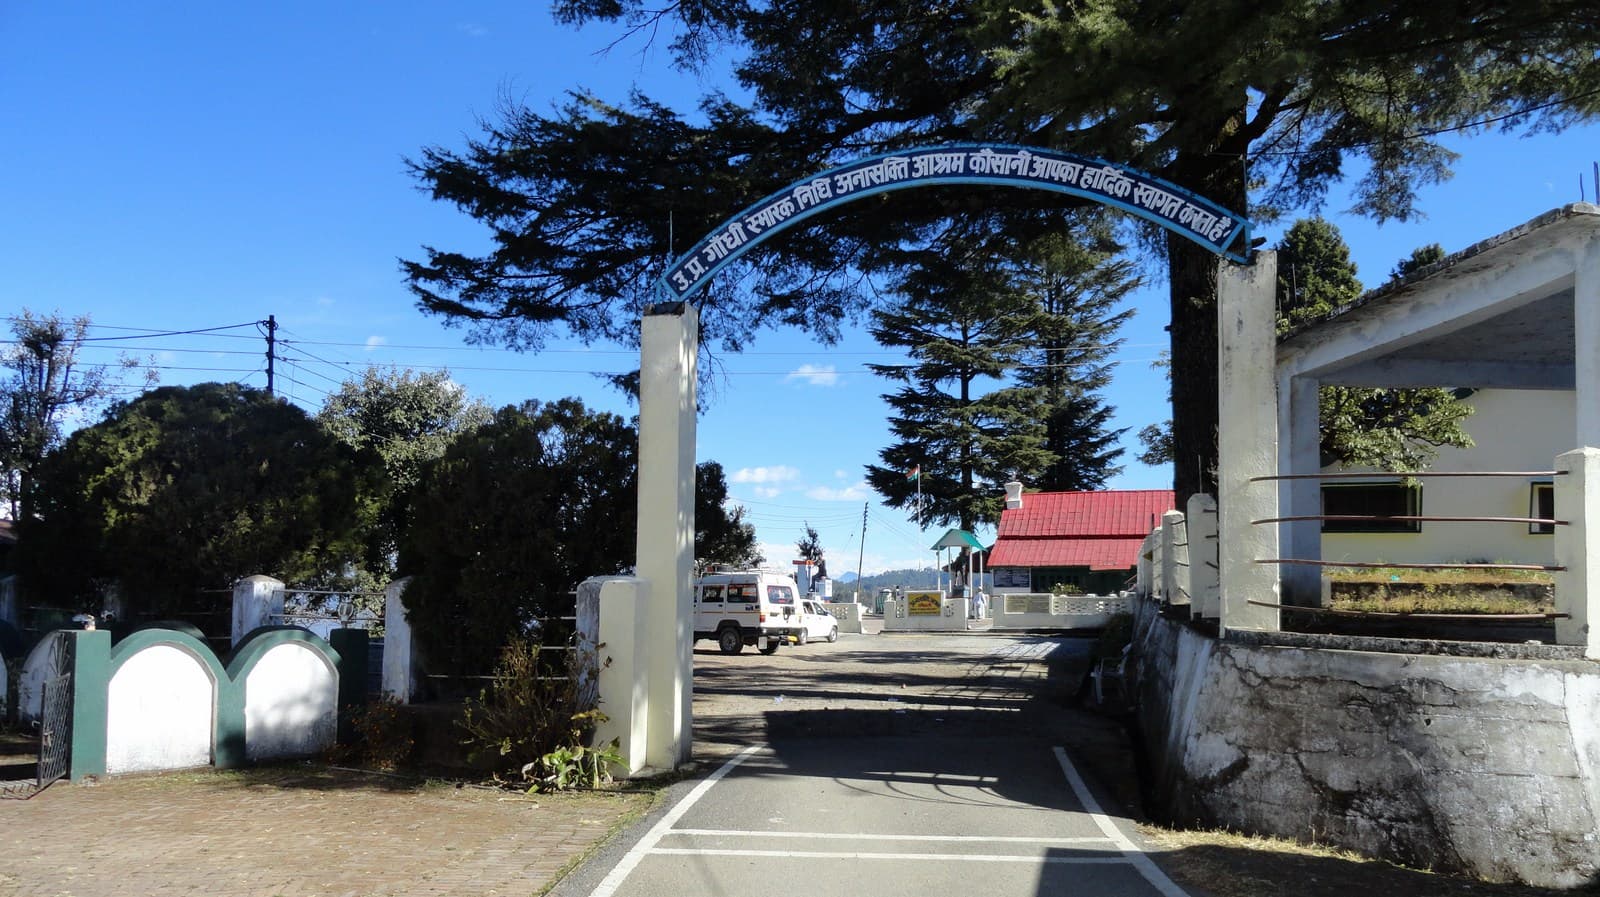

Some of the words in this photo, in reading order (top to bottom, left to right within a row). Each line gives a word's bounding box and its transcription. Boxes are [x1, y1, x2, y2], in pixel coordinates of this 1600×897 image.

[745, 196, 795, 234] स्मारक
[793, 177, 833, 211] निधि
[835, 157, 910, 195] अनासक्ति
[912, 152, 967, 178] आश्रम
[969, 148, 1032, 176] कौसानी
[1028, 155, 1084, 185] आपका
[1079, 165, 1135, 198] हार्दिक
[1133, 181, 1185, 218] स्वागत
